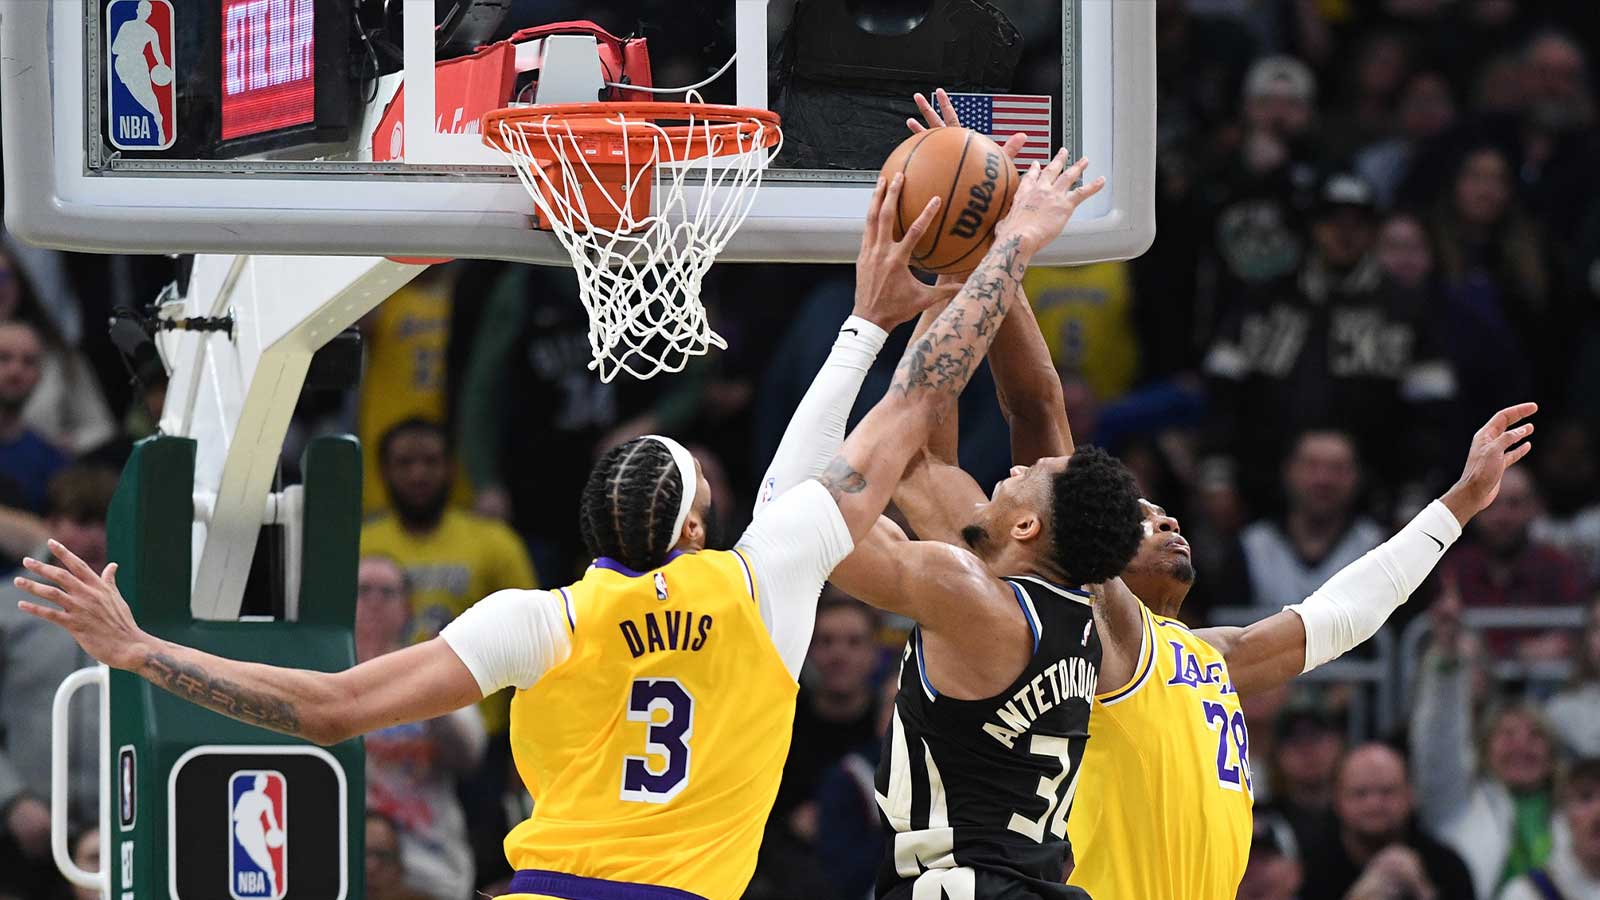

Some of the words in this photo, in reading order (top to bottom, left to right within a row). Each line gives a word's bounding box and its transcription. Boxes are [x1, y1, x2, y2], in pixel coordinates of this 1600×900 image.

[119, 115, 151, 139] NBA
[949, 152, 999, 239] Wilson
[619, 610, 713, 659] DAVIS
[619, 676, 695, 804] 3
[1201, 698, 1254, 792] 28
[238, 870, 266, 894] NBA
